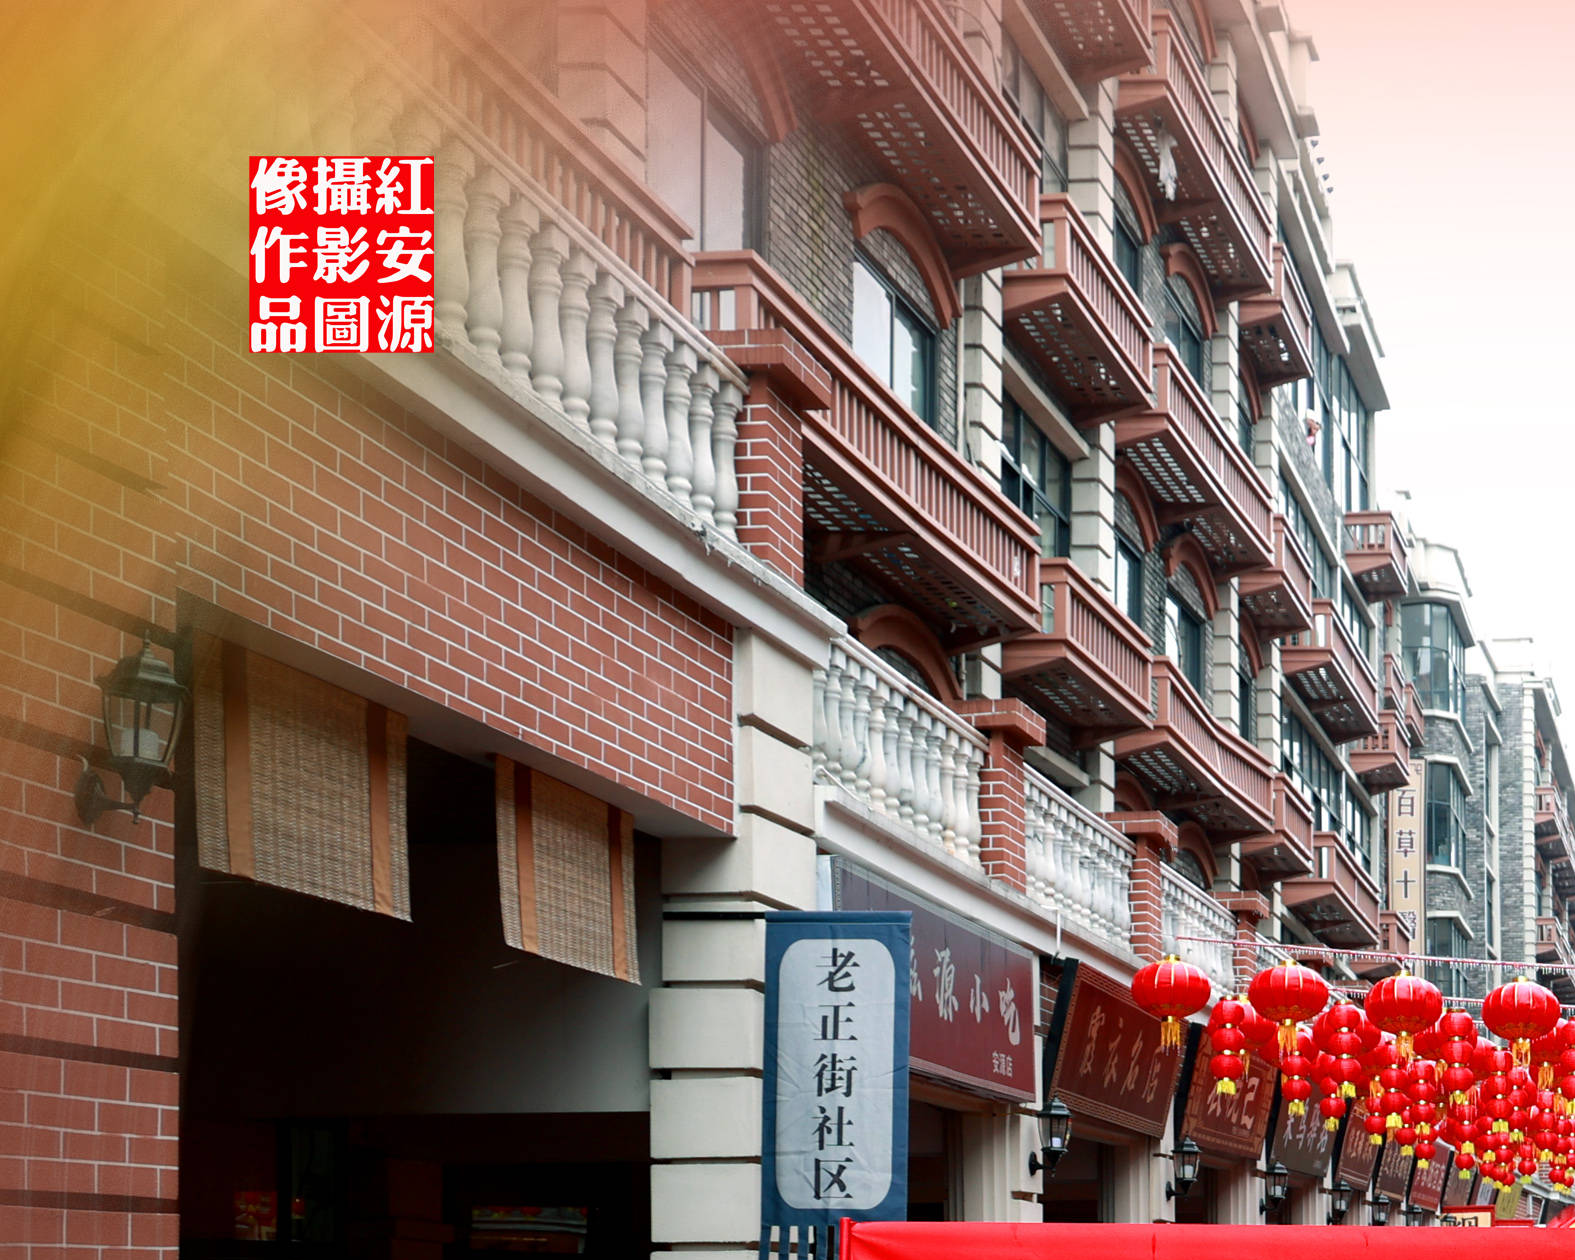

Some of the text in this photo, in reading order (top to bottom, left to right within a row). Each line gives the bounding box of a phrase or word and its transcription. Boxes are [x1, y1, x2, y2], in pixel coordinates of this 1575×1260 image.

[812, 947, 861, 1201] 老正街社区
